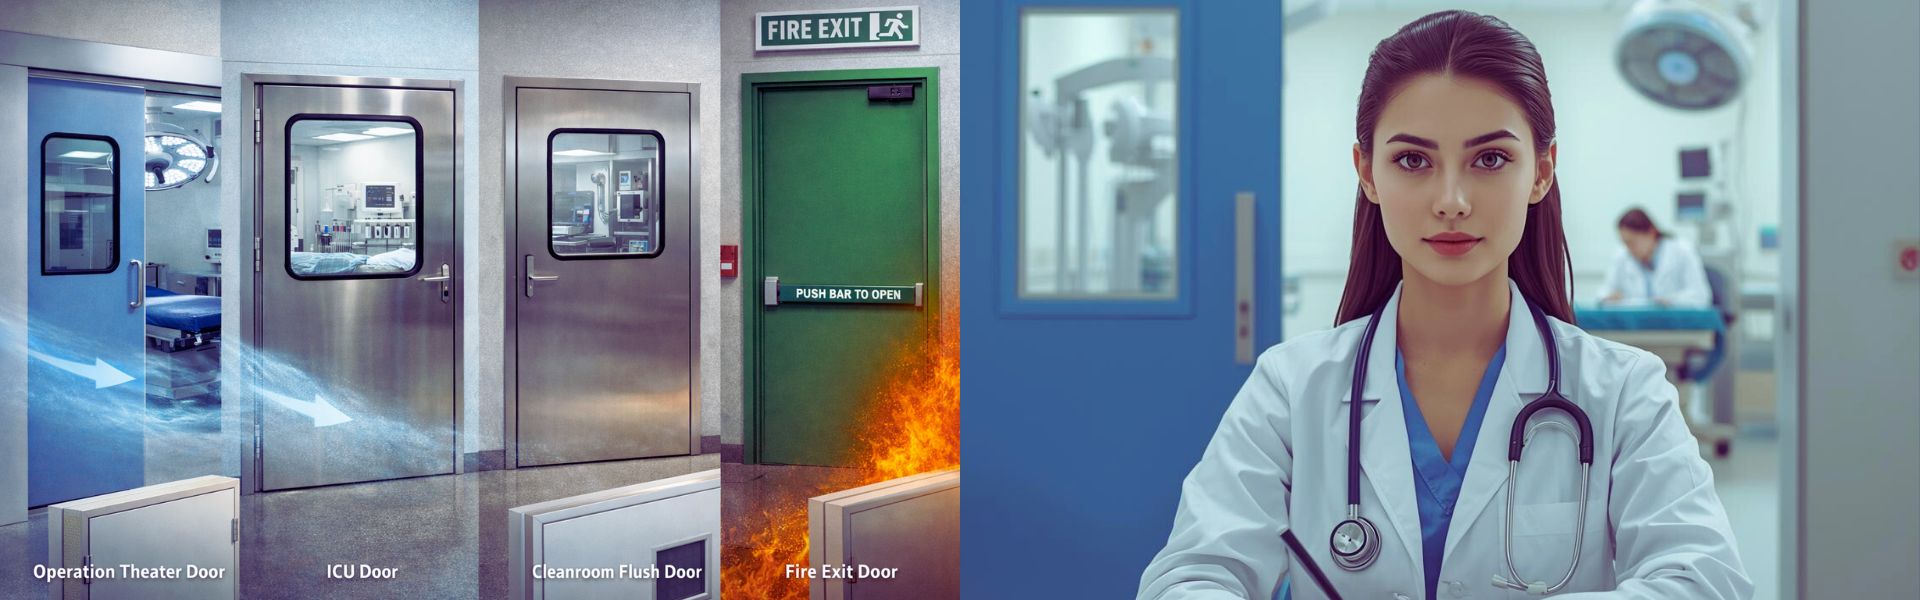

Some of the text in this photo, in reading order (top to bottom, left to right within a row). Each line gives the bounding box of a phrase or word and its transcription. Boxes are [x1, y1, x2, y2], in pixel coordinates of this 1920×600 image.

[767, 17, 863, 41] FIRE EXIT
[796, 288, 901, 300] PUSH BAR TO OPEN
